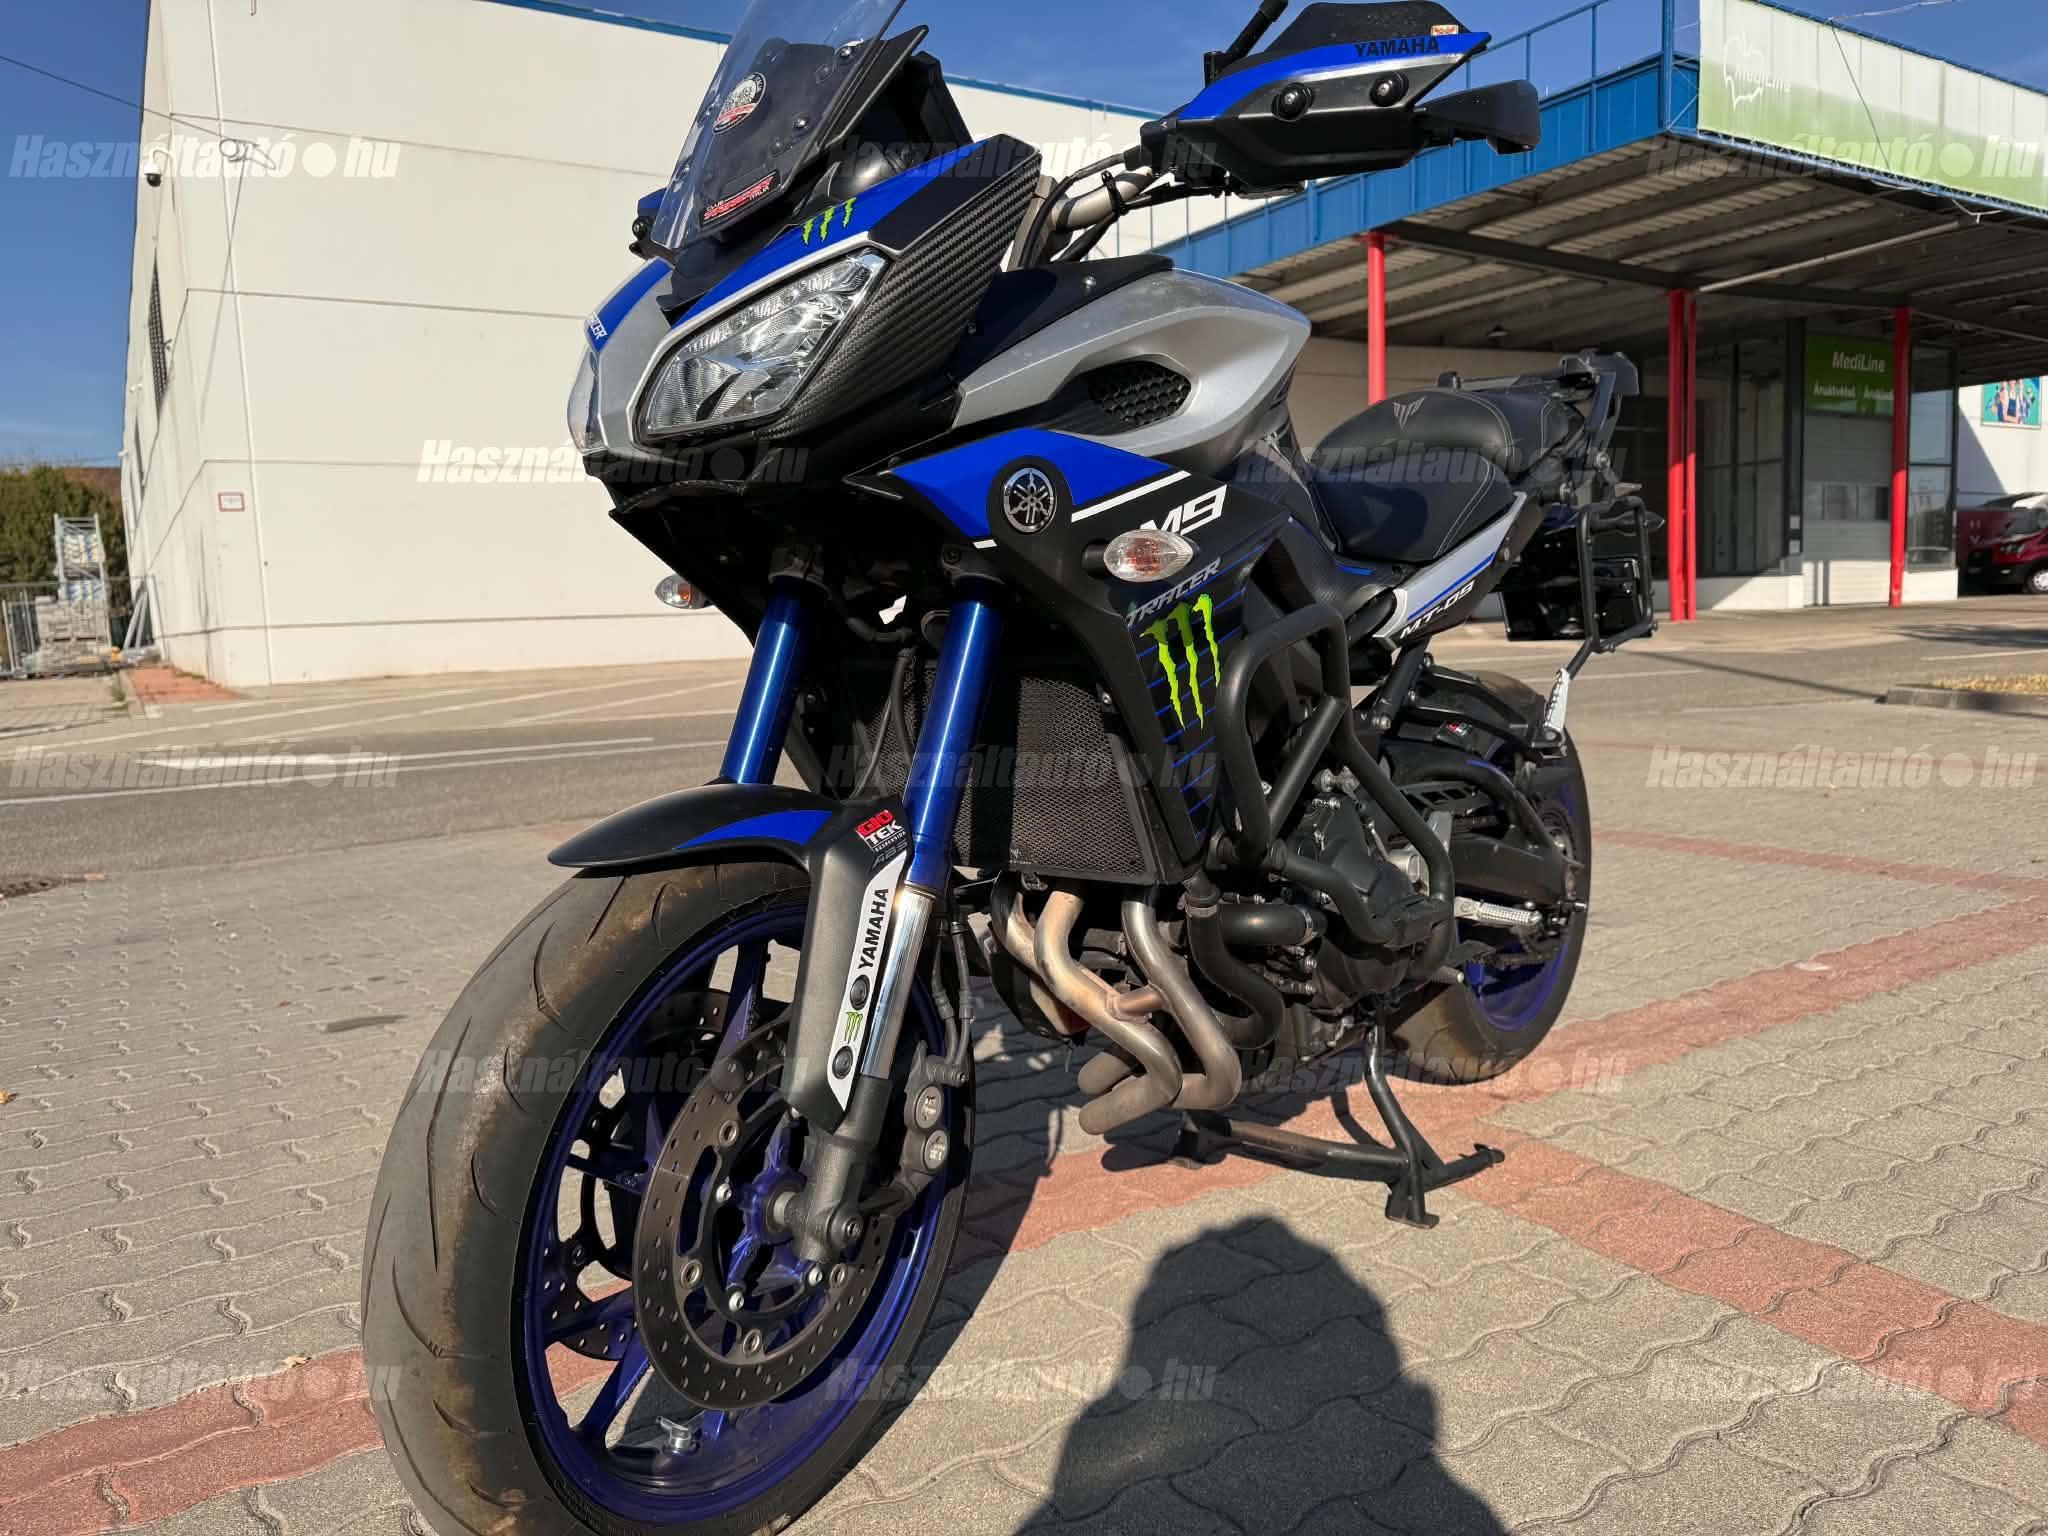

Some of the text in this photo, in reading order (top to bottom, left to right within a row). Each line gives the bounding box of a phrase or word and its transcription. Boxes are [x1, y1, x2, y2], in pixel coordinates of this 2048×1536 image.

[1354, 37, 1440, 58] YAMAHA
[1831, 351, 1886, 373] MediLine
[1125, 556, 1222, 628] TRACER
[1400, 579, 1476, 640] MT-09
[863, 822, 903, 844] TEK
[857, 887, 890, 970] YAMAHA
